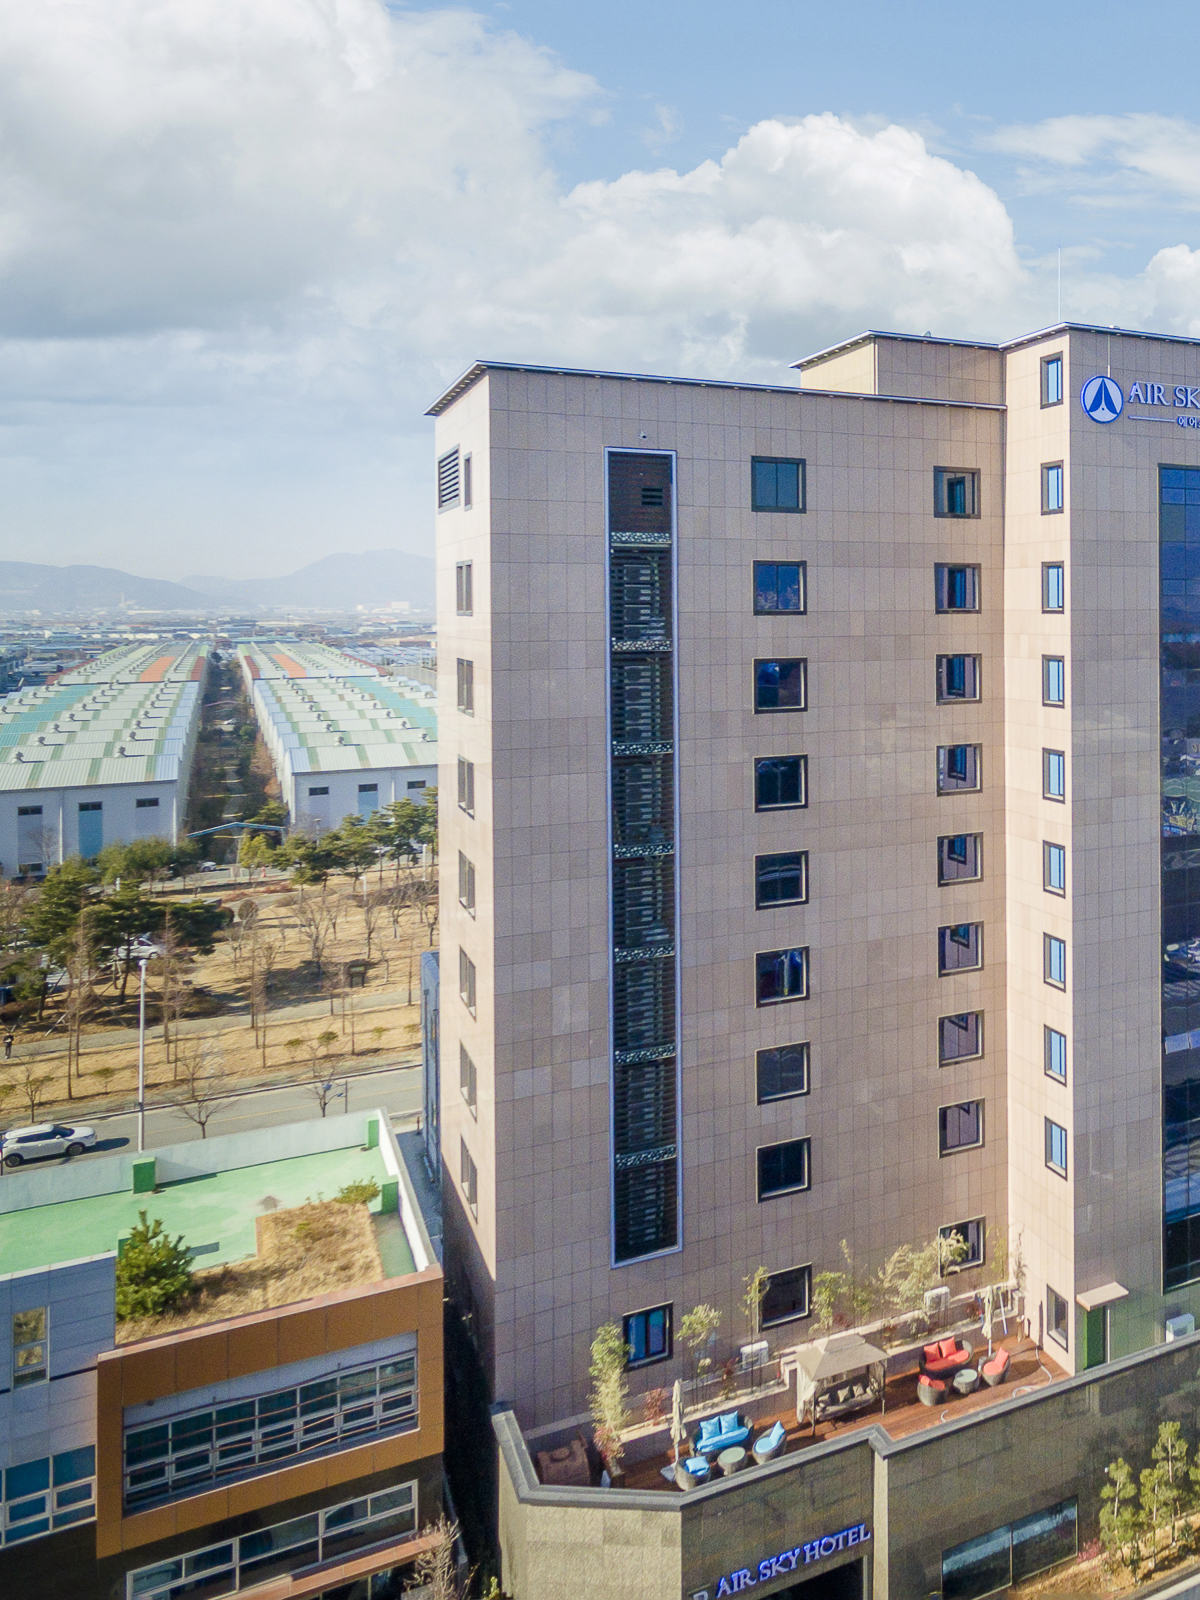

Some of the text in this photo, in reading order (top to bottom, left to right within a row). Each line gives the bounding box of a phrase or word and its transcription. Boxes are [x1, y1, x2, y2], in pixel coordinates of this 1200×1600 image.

[1129, 382, 1170, 406] AIR
[716, 1523, 872, 1598] AIR SKY HOTEL
